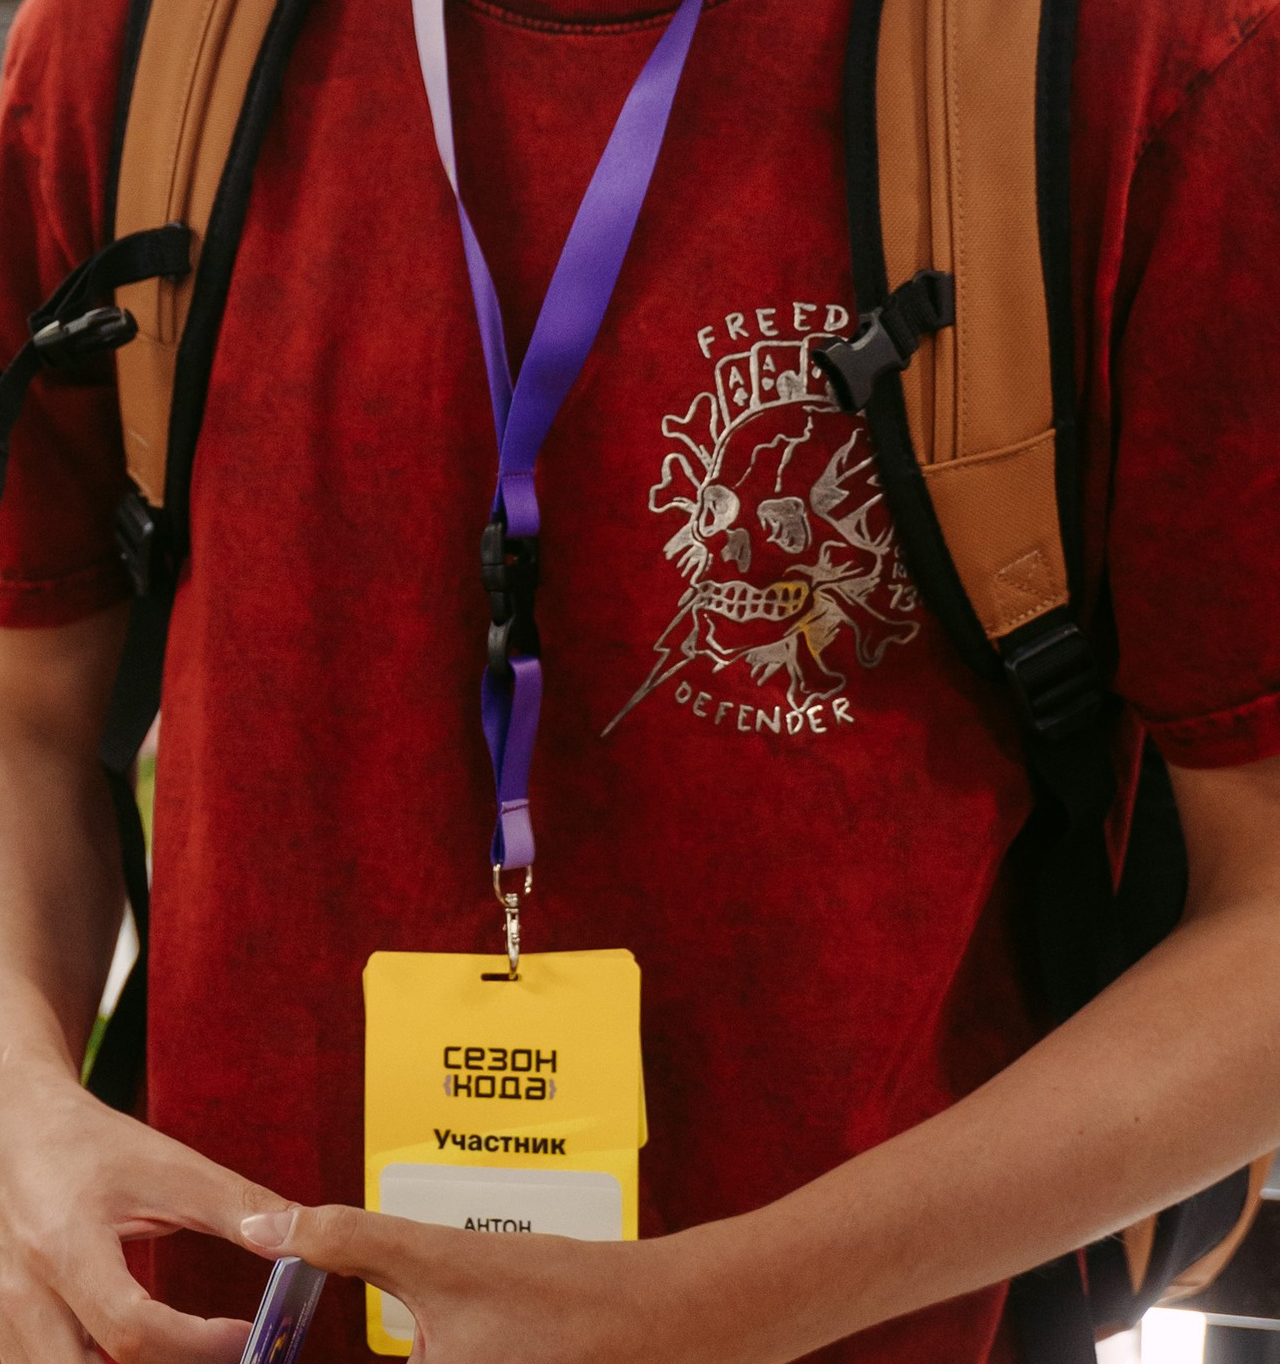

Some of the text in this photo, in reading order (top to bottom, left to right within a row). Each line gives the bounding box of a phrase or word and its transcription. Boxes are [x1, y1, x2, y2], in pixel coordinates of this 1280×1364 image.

[697, 301, 850, 359] FREED
[674, 681, 855, 735] DEFENDER
[433, 1128, 566, 1155] Участник
[464, 1217, 531, 1234] АНТОН
